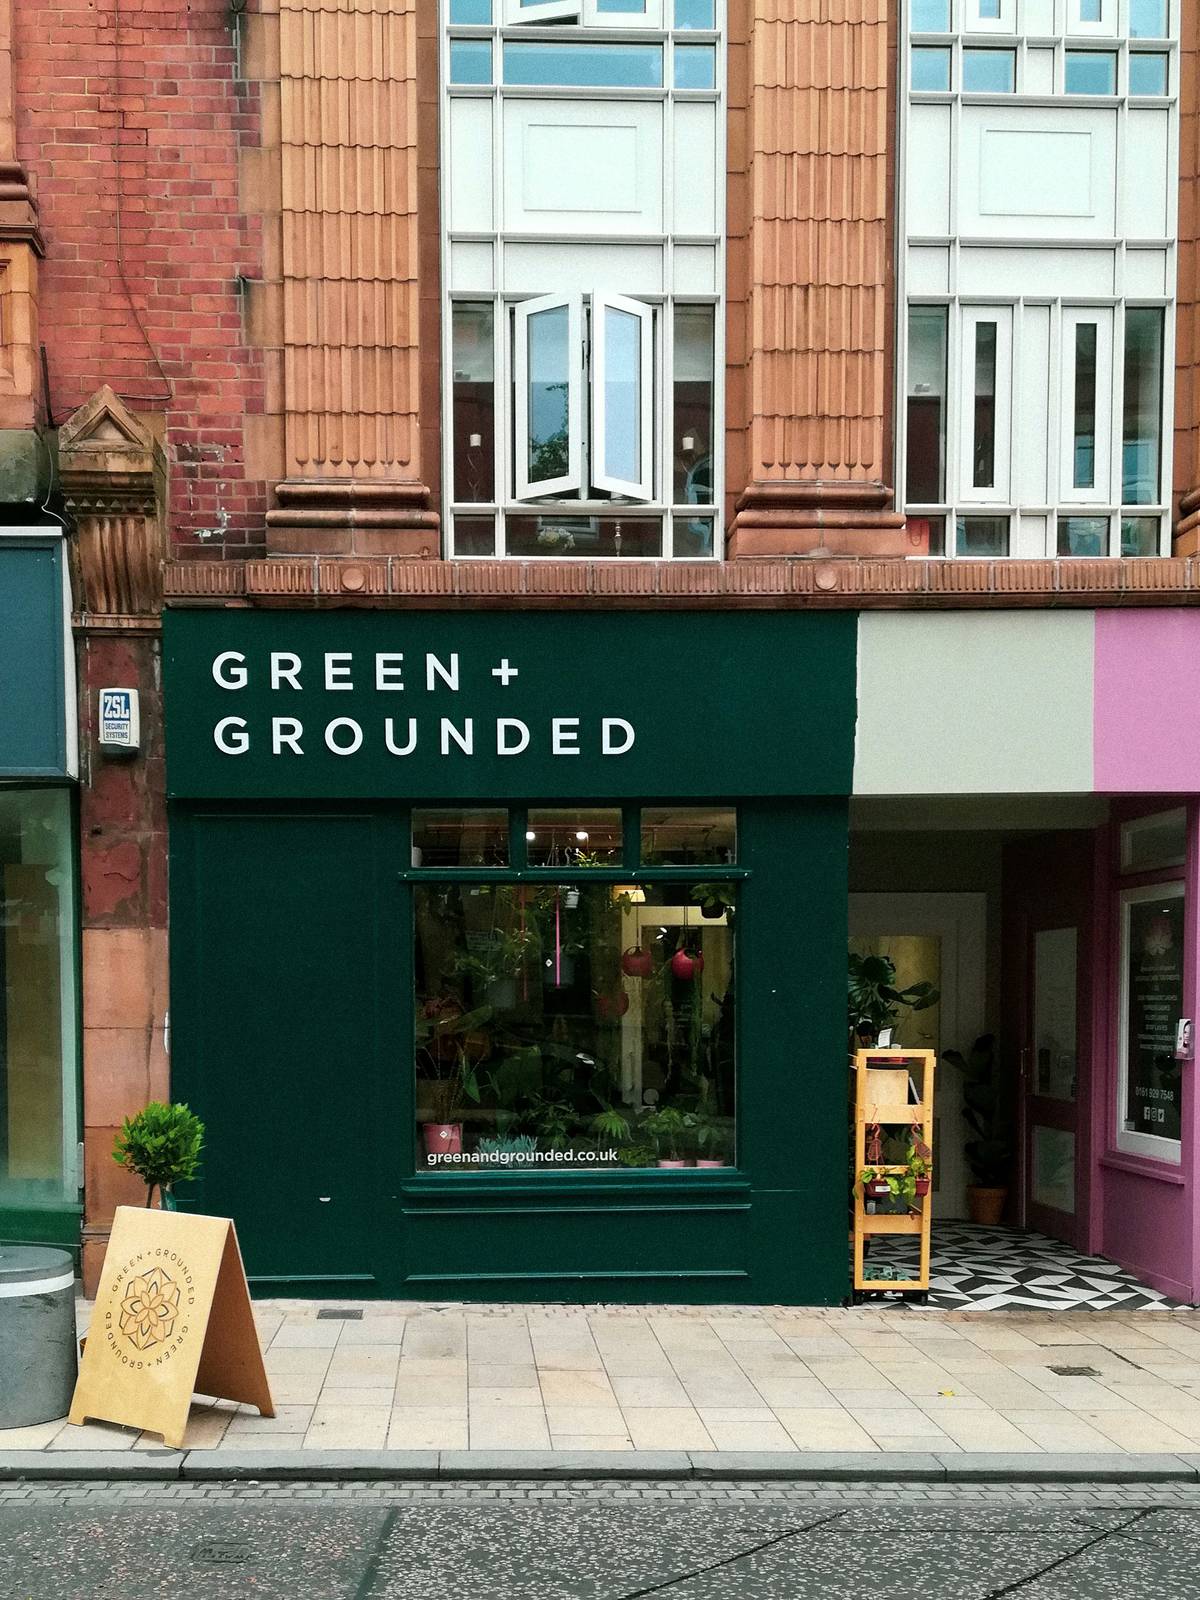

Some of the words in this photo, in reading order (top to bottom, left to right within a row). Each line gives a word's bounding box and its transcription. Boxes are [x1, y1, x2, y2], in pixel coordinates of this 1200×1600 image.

[213, 651, 459, 690] GREEN
[491, 659, 519, 686] +
[104, 695, 130, 719] ZSL
[105, 722, 129, 730] SECURITY
[105, 731, 129, 739] SYSTEMS
[213, 717, 636, 756] GROUNDED
[1135, 1086, 1148, 1096] 0161
[427, 1149, 618, 1165] greenandgrounded.co.uk
[111, 1254, 143, 1292] GREEN
[155, 1248, 195, 1305] GROUNDED
[105, 1311, 143, 1370] GROUNDED
[156, 1325, 188, 1365] GREEN
